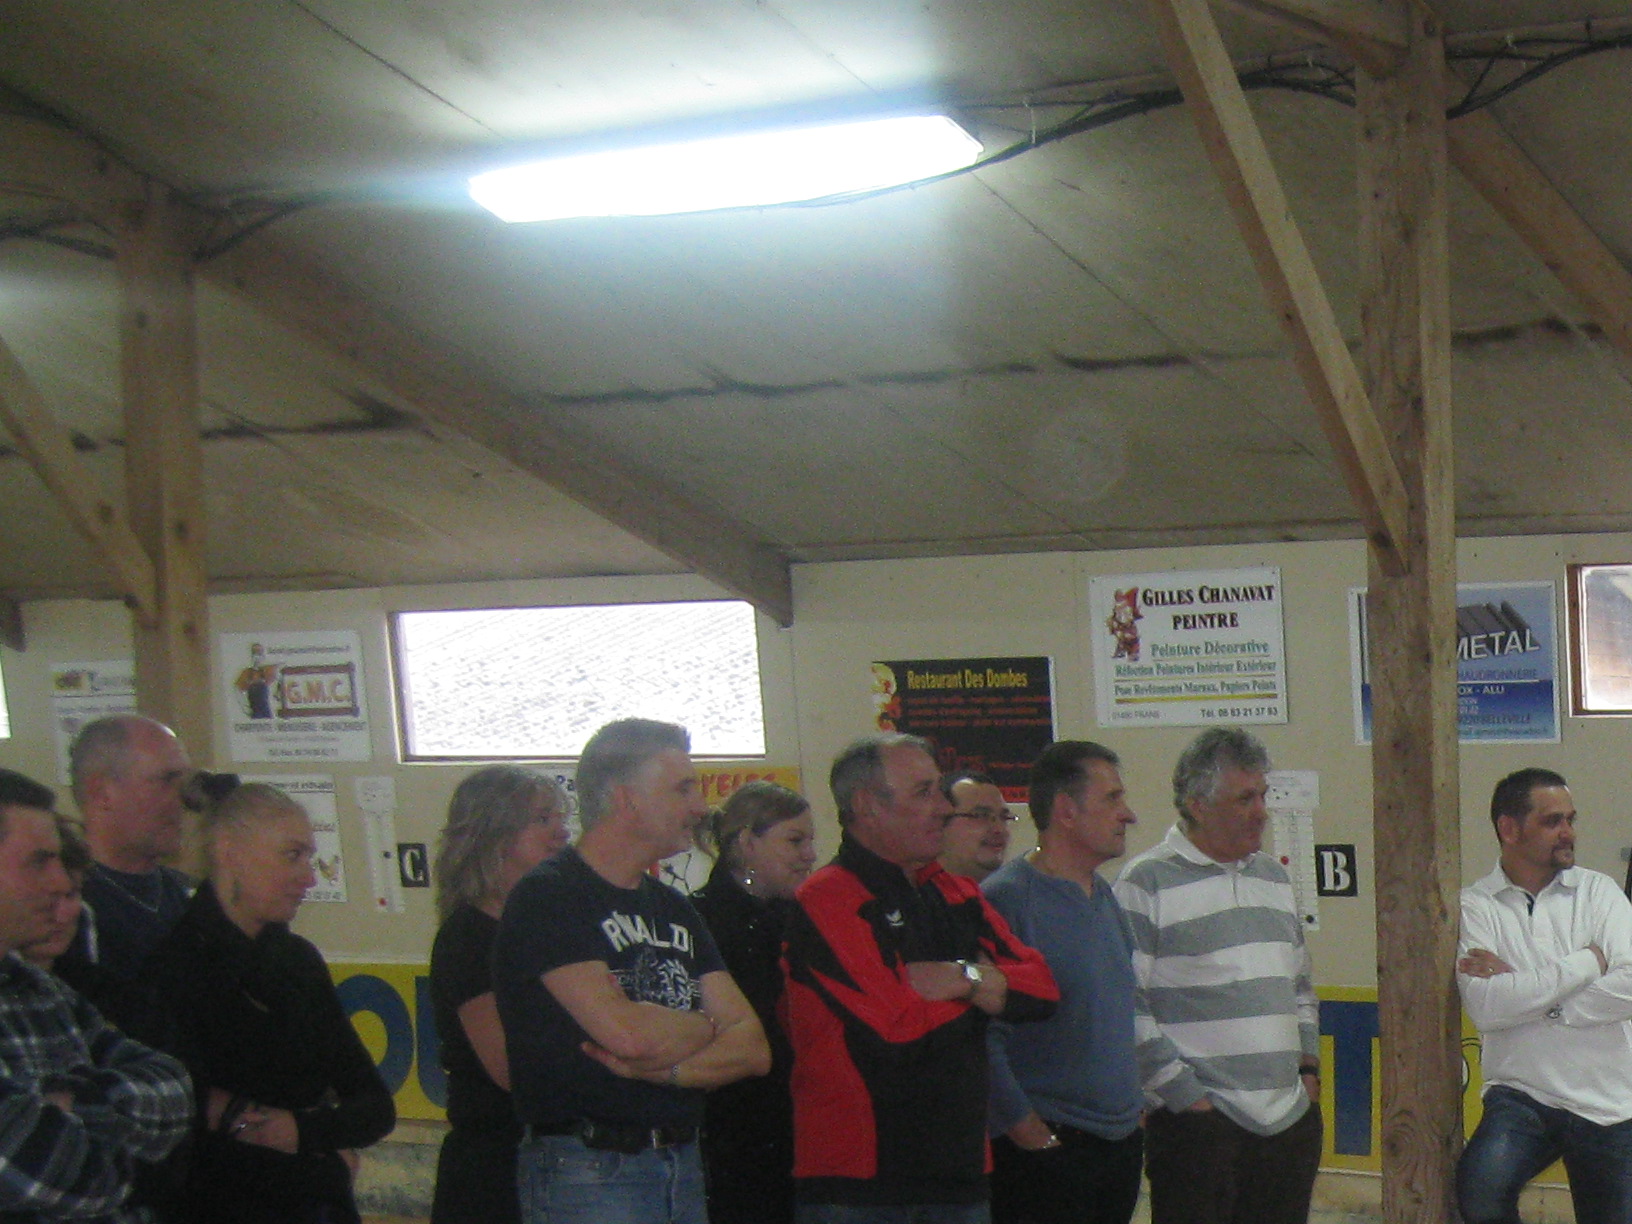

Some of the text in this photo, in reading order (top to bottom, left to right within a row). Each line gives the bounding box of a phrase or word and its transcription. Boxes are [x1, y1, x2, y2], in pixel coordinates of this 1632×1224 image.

[1142, 584, 1275, 607] GILLES CHANAVAT
[1172, 612, 1239, 630] PEINTRE
[907, 669, 963, 689] Restaurant
[986, 668, 1028, 688] Dombes
[403, 848, 424, 882] C
[1321, 850, 1351, 891] B
